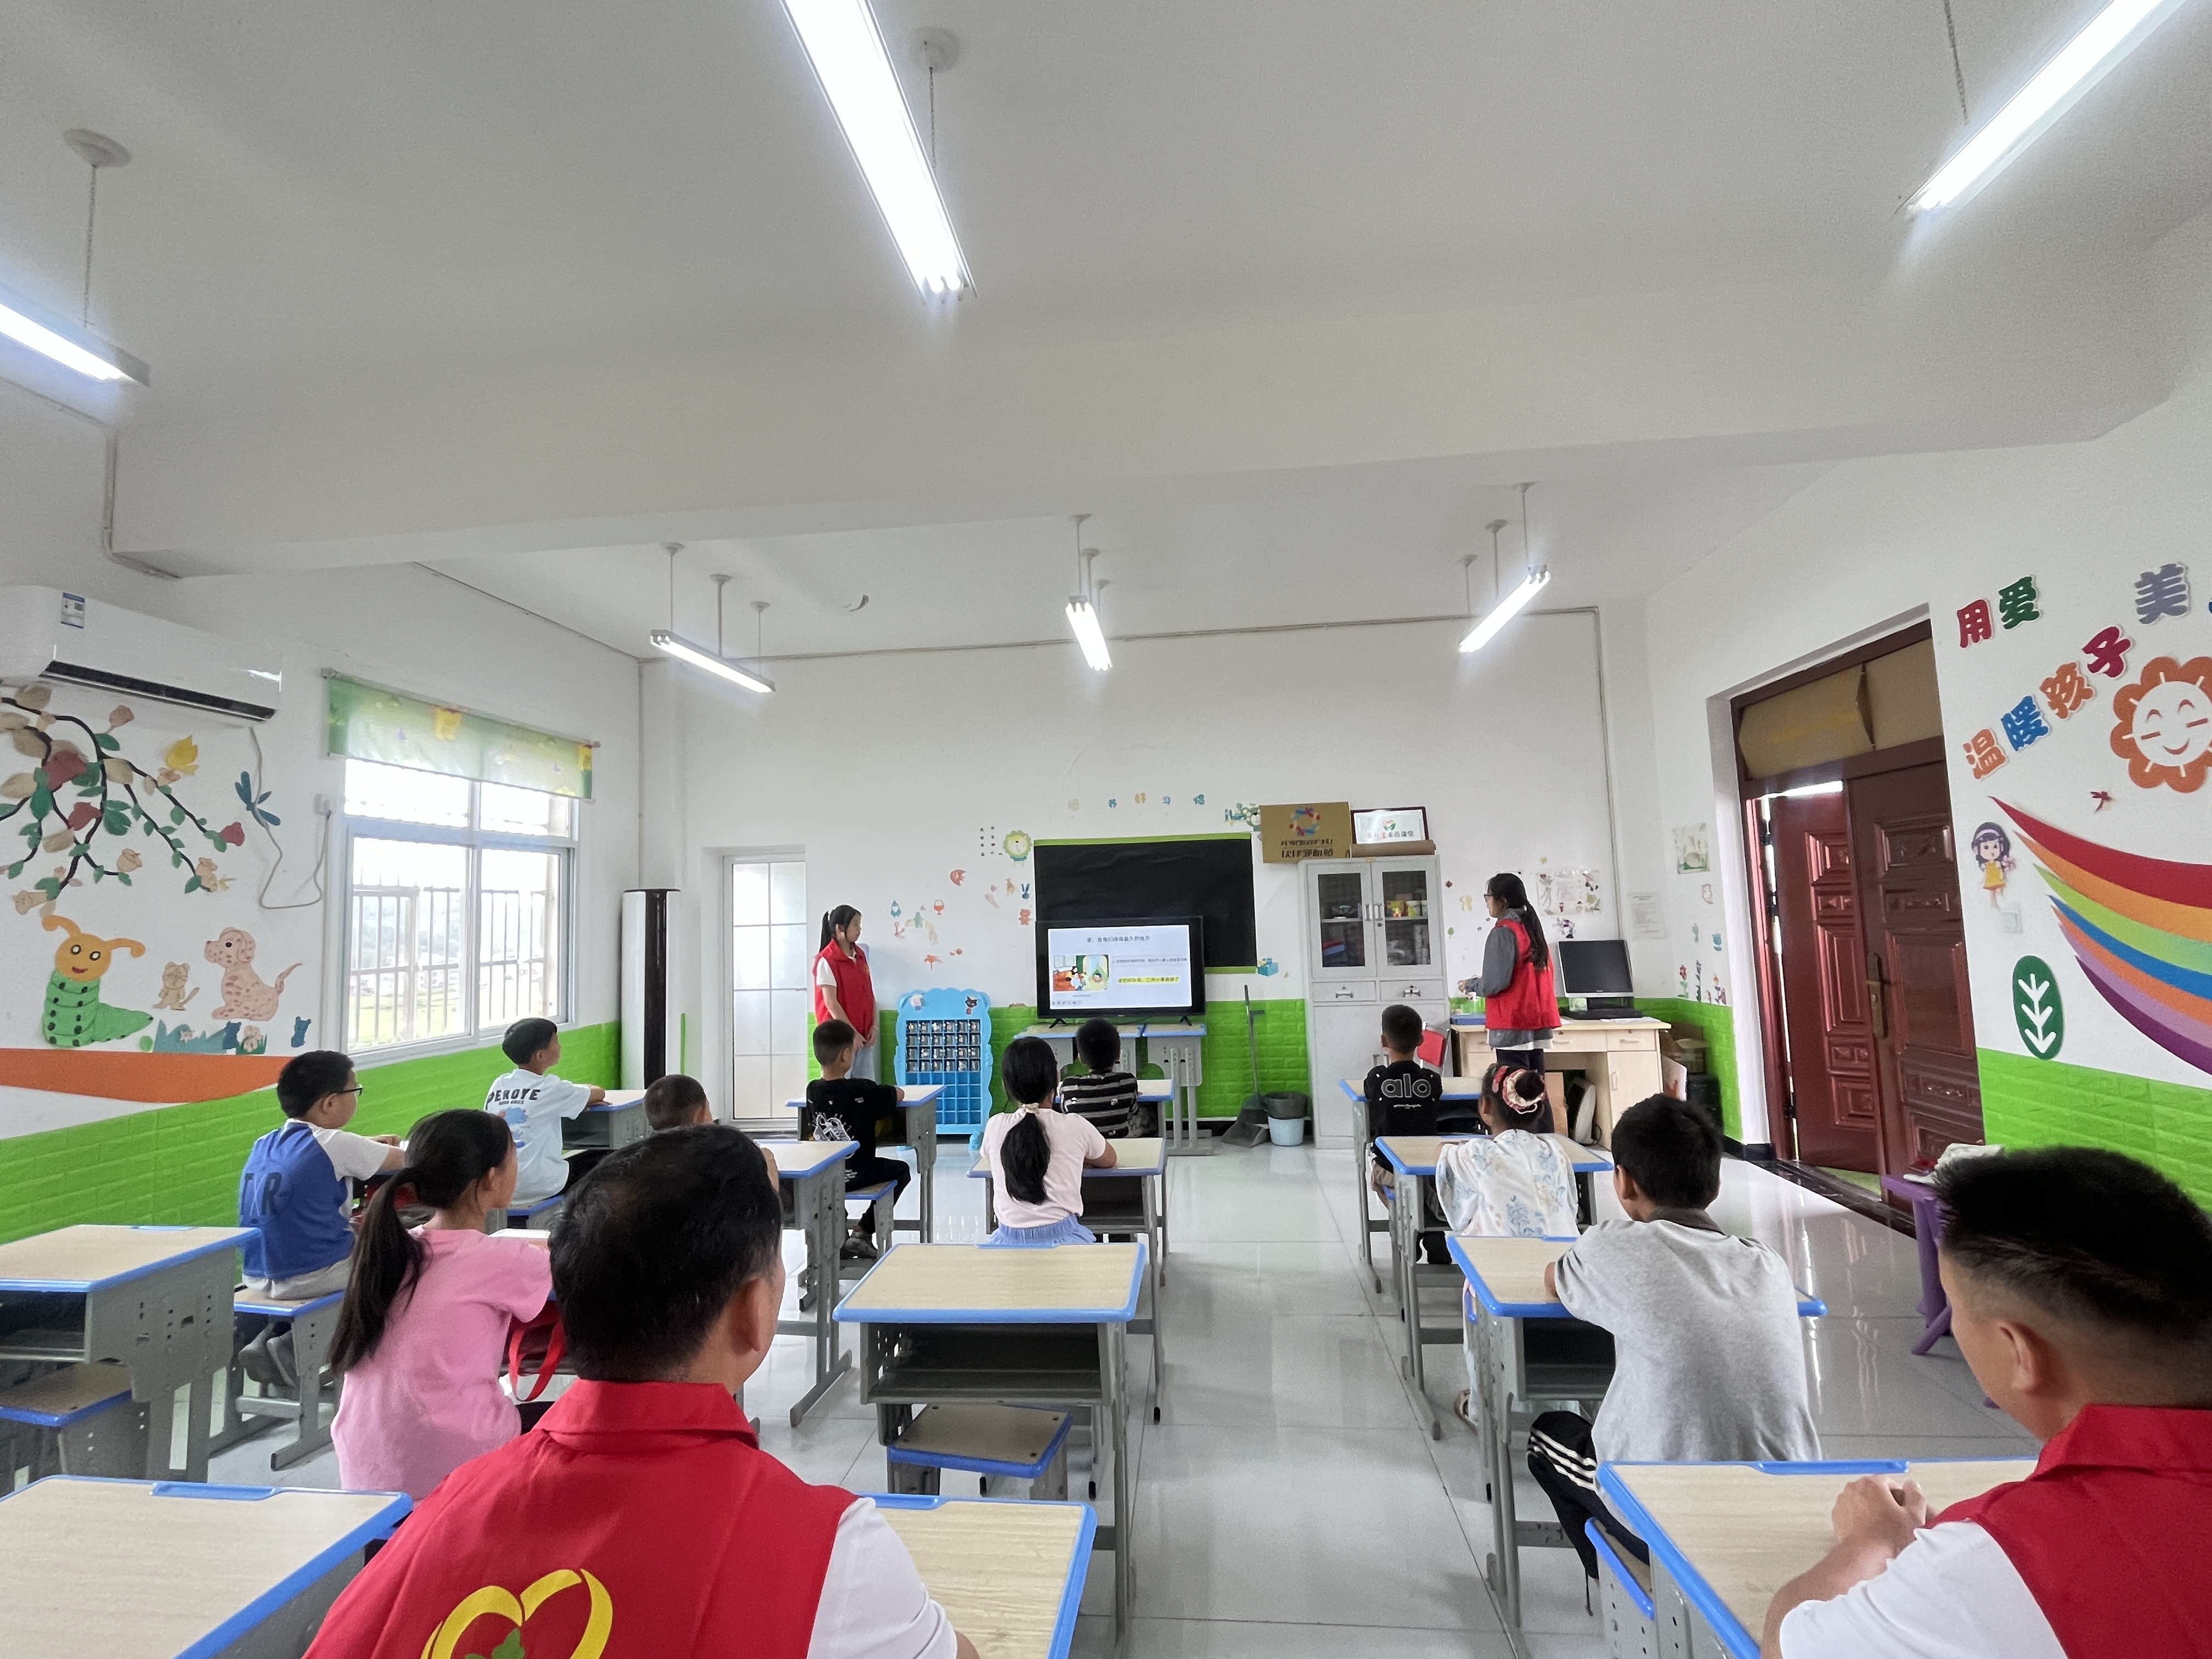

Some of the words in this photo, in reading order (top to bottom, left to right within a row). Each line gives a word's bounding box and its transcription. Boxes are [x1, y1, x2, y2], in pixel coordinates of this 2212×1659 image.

[1957, 576, 2040, 648] 用爱
[2135, 563, 2212, 624] 美
[1963, 627, 2131, 780] 温暖孩子
[1381, 1074, 1431, 1098] alo
